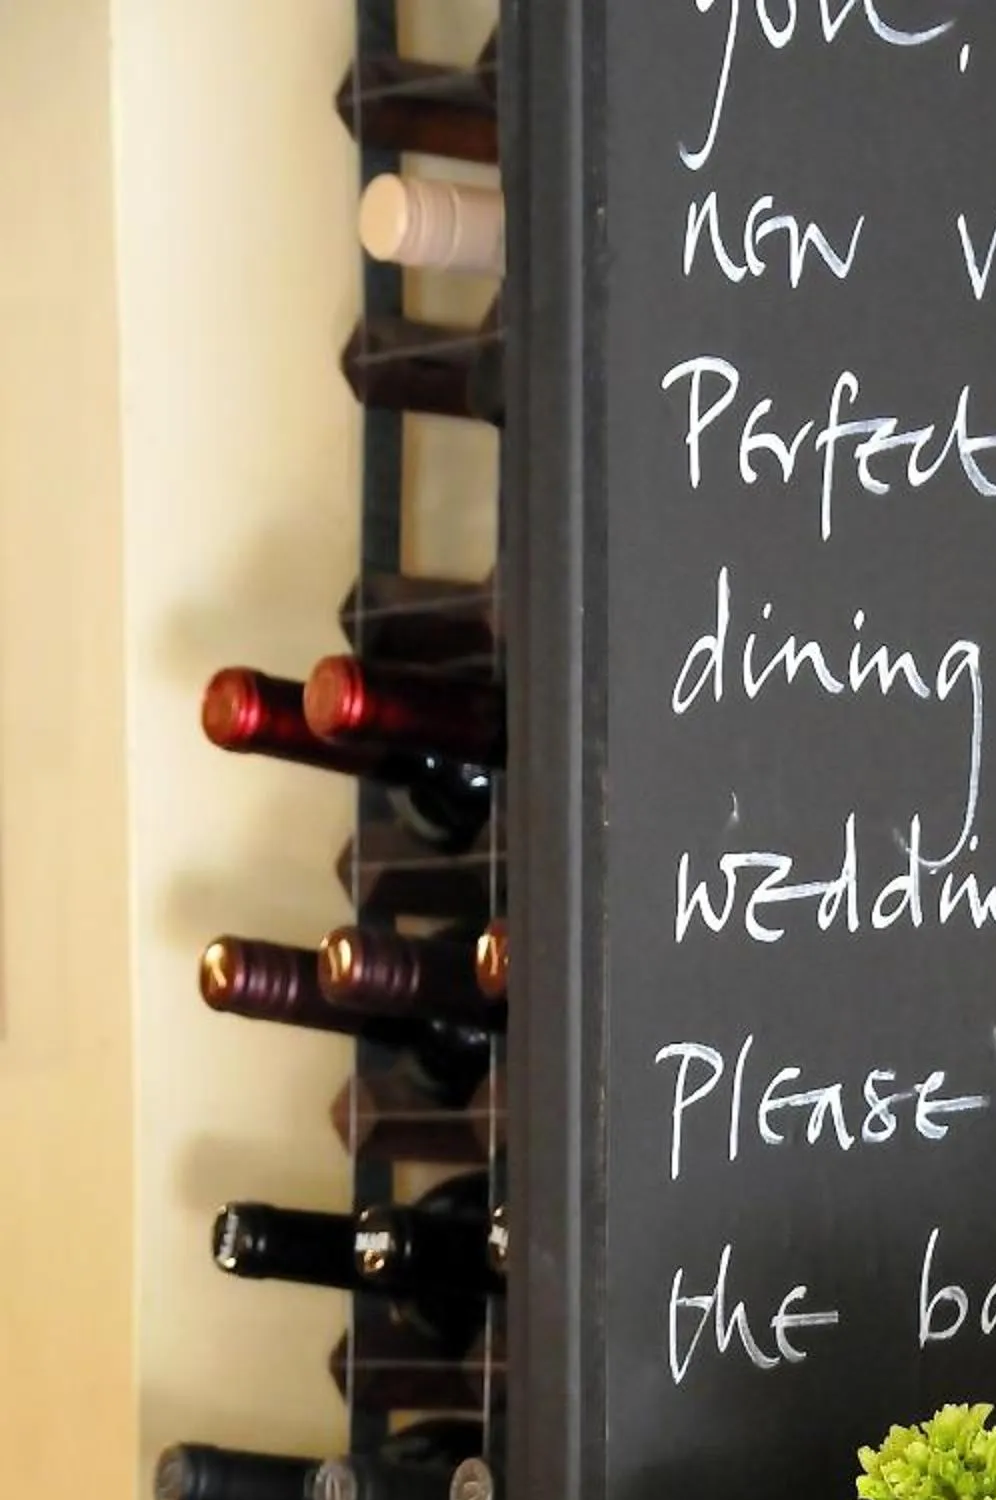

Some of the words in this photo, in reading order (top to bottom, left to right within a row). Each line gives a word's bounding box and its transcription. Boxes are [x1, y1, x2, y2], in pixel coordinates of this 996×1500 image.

[683, 190, 865, 290] new
[654, 1032, 990, 1182] Please
[668, 1242, 840, 1386] the
